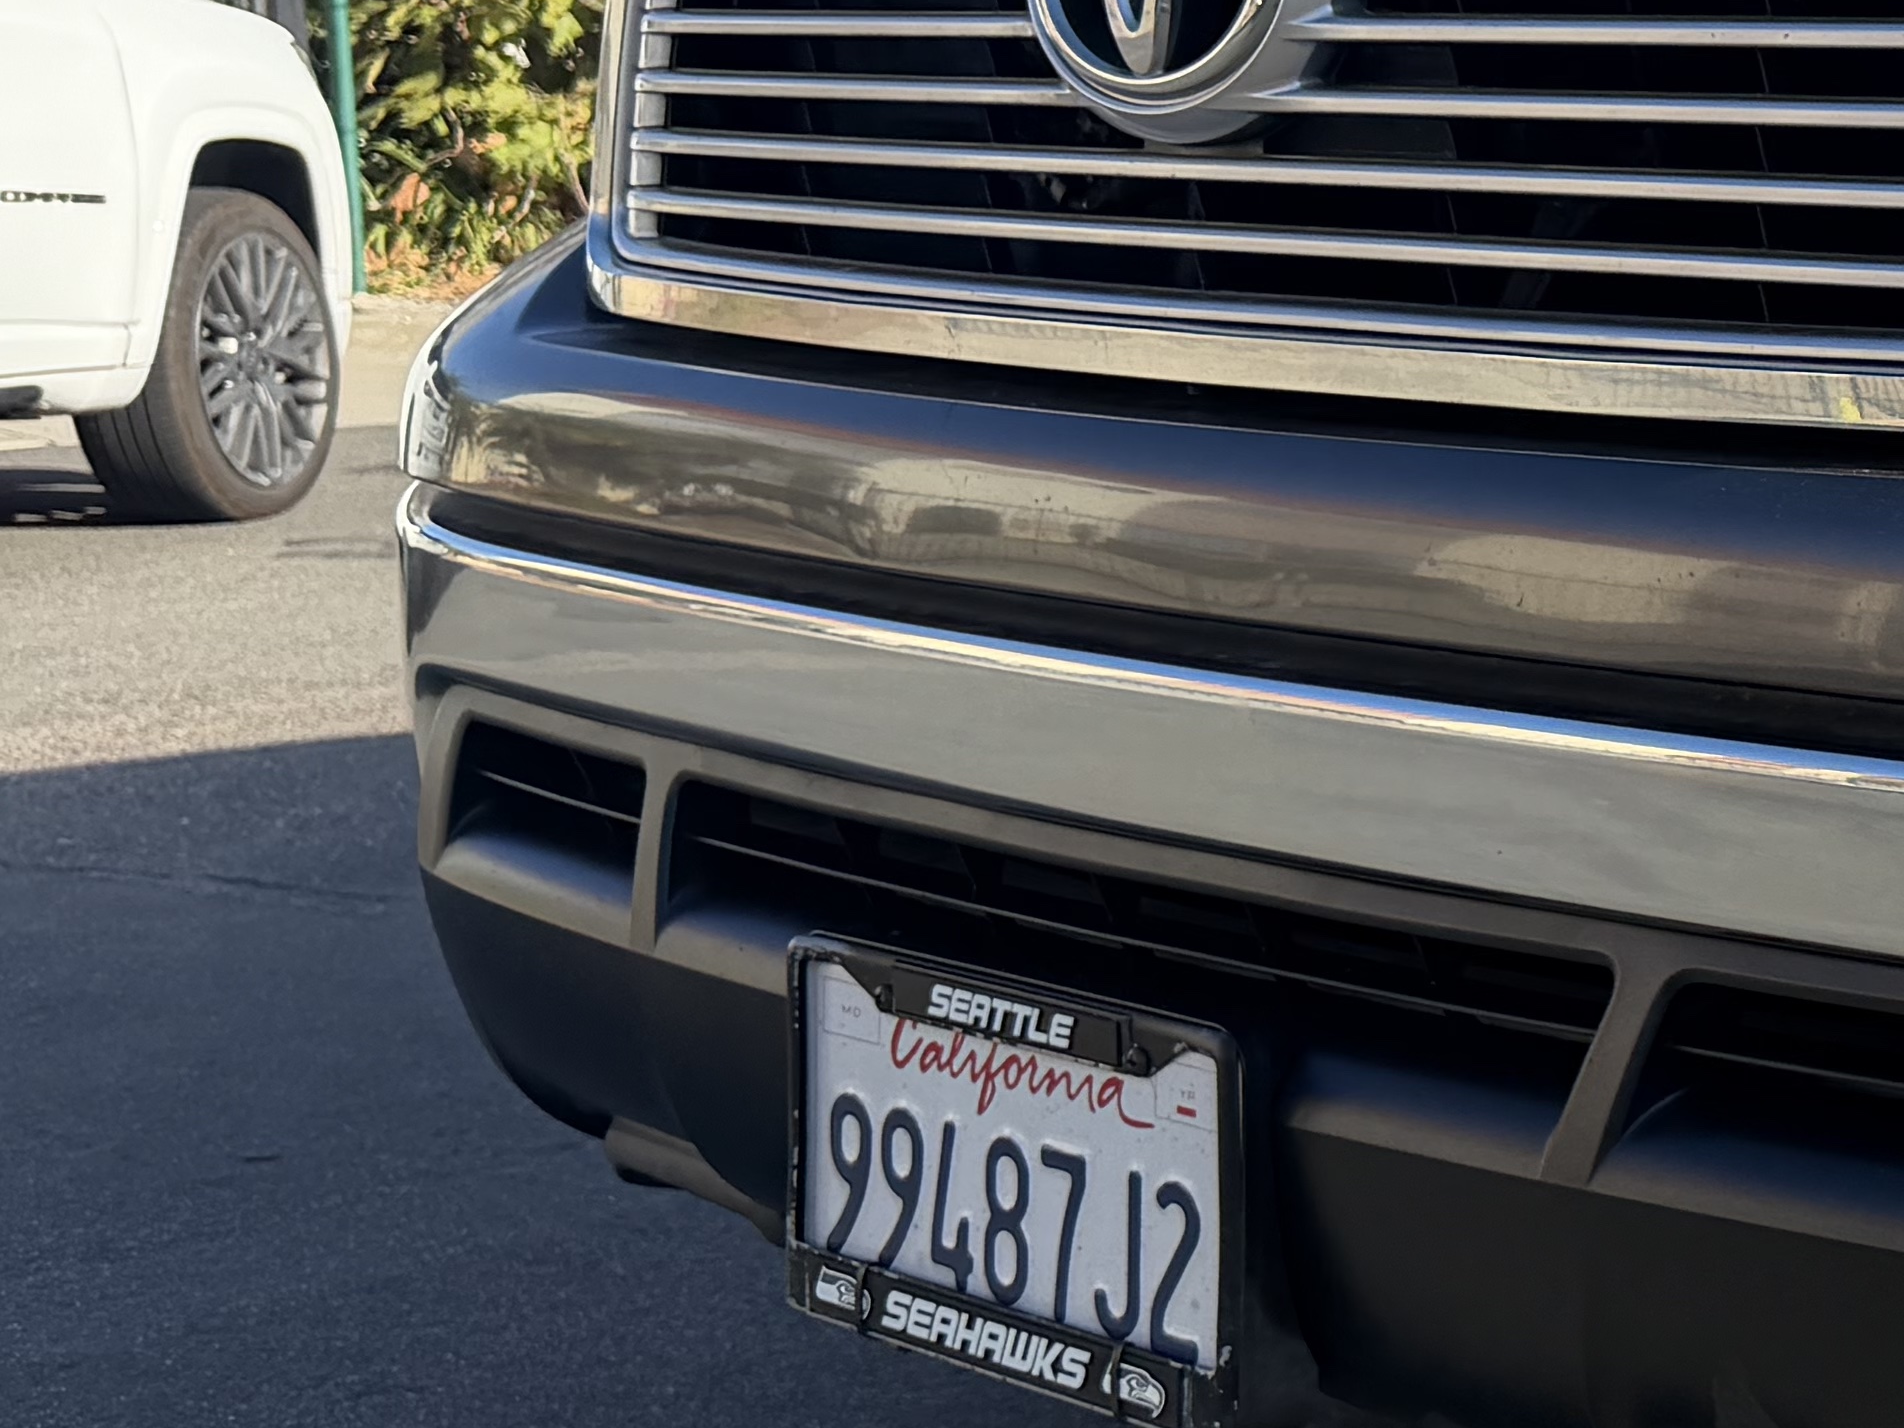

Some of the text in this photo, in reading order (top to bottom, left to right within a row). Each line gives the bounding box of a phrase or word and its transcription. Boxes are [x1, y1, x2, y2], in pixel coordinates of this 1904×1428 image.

[928, 983, 1076, 1050] SEATTLE
[890, 1018, 1155, 1129] California
[826, 1092, 1201, 1368] 99487J2
[881, 1289, 1092, 1392] SEAHAWKS
